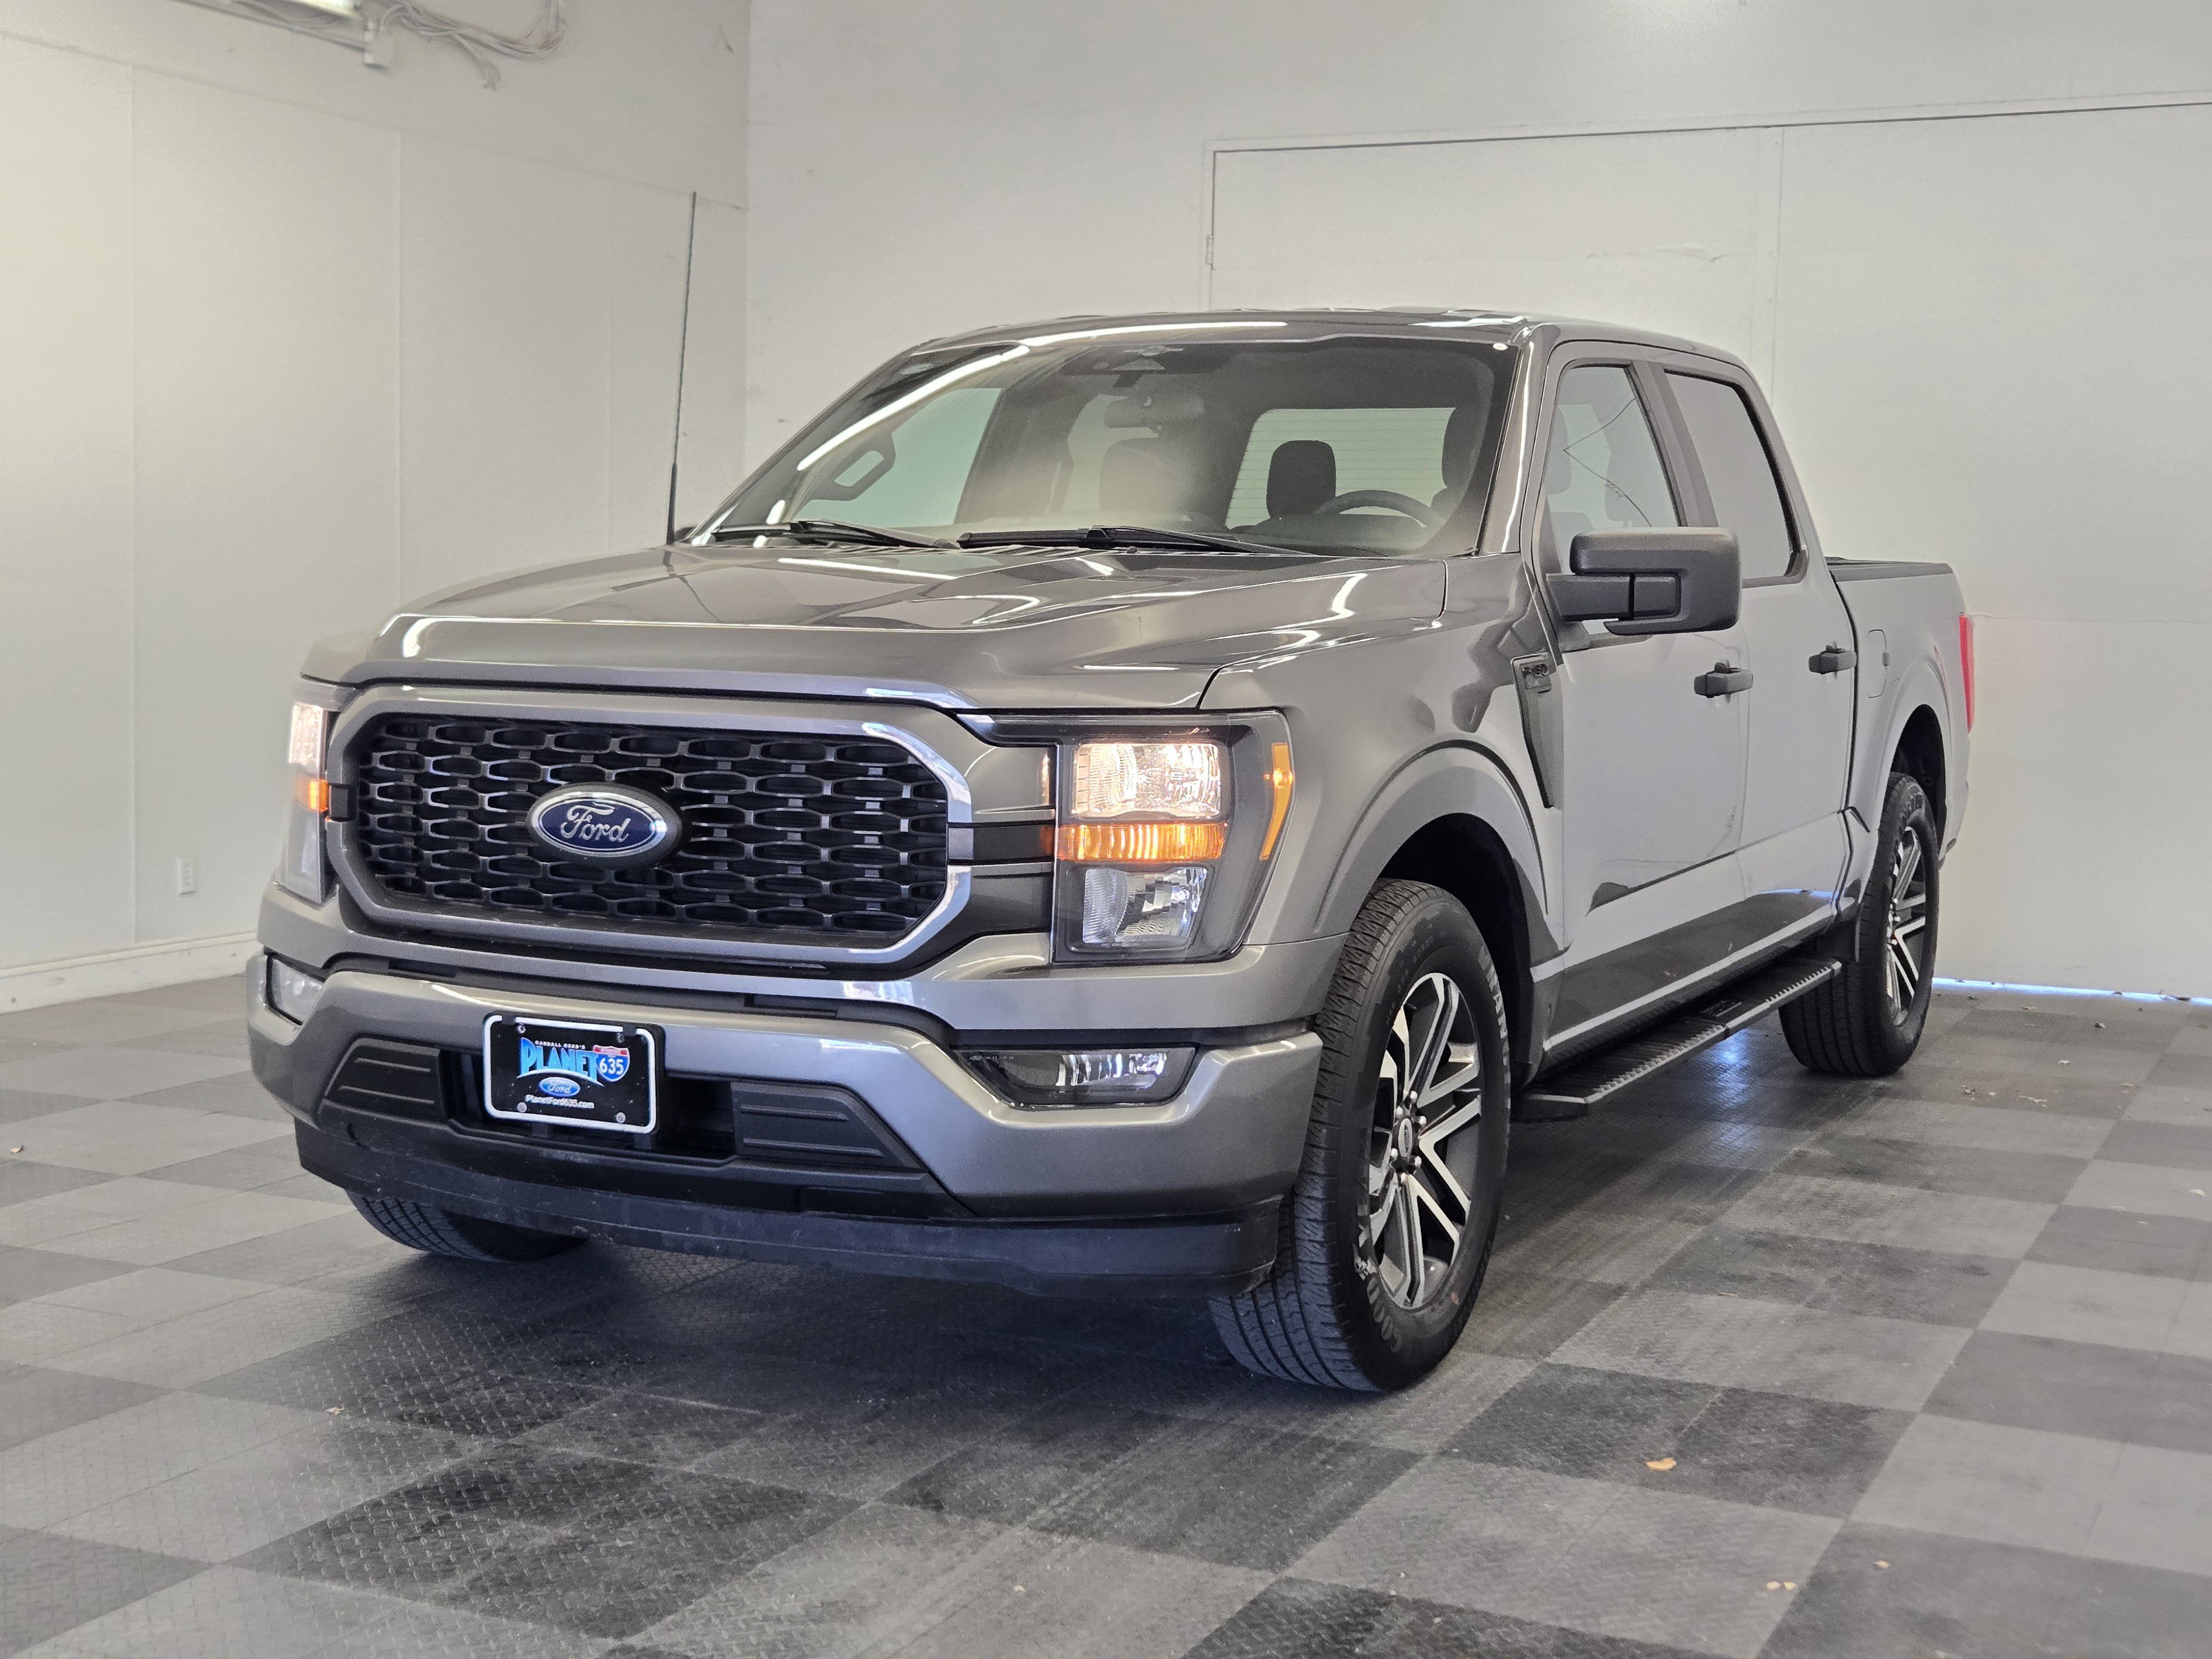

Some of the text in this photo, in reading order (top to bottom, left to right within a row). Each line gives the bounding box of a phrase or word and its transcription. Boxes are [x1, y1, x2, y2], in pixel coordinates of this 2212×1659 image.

[560, 801, 632, 843] Ford
[520, 1037, 624, 1081] PLANET 635
[547, 1079, 572, 1093] Ford
